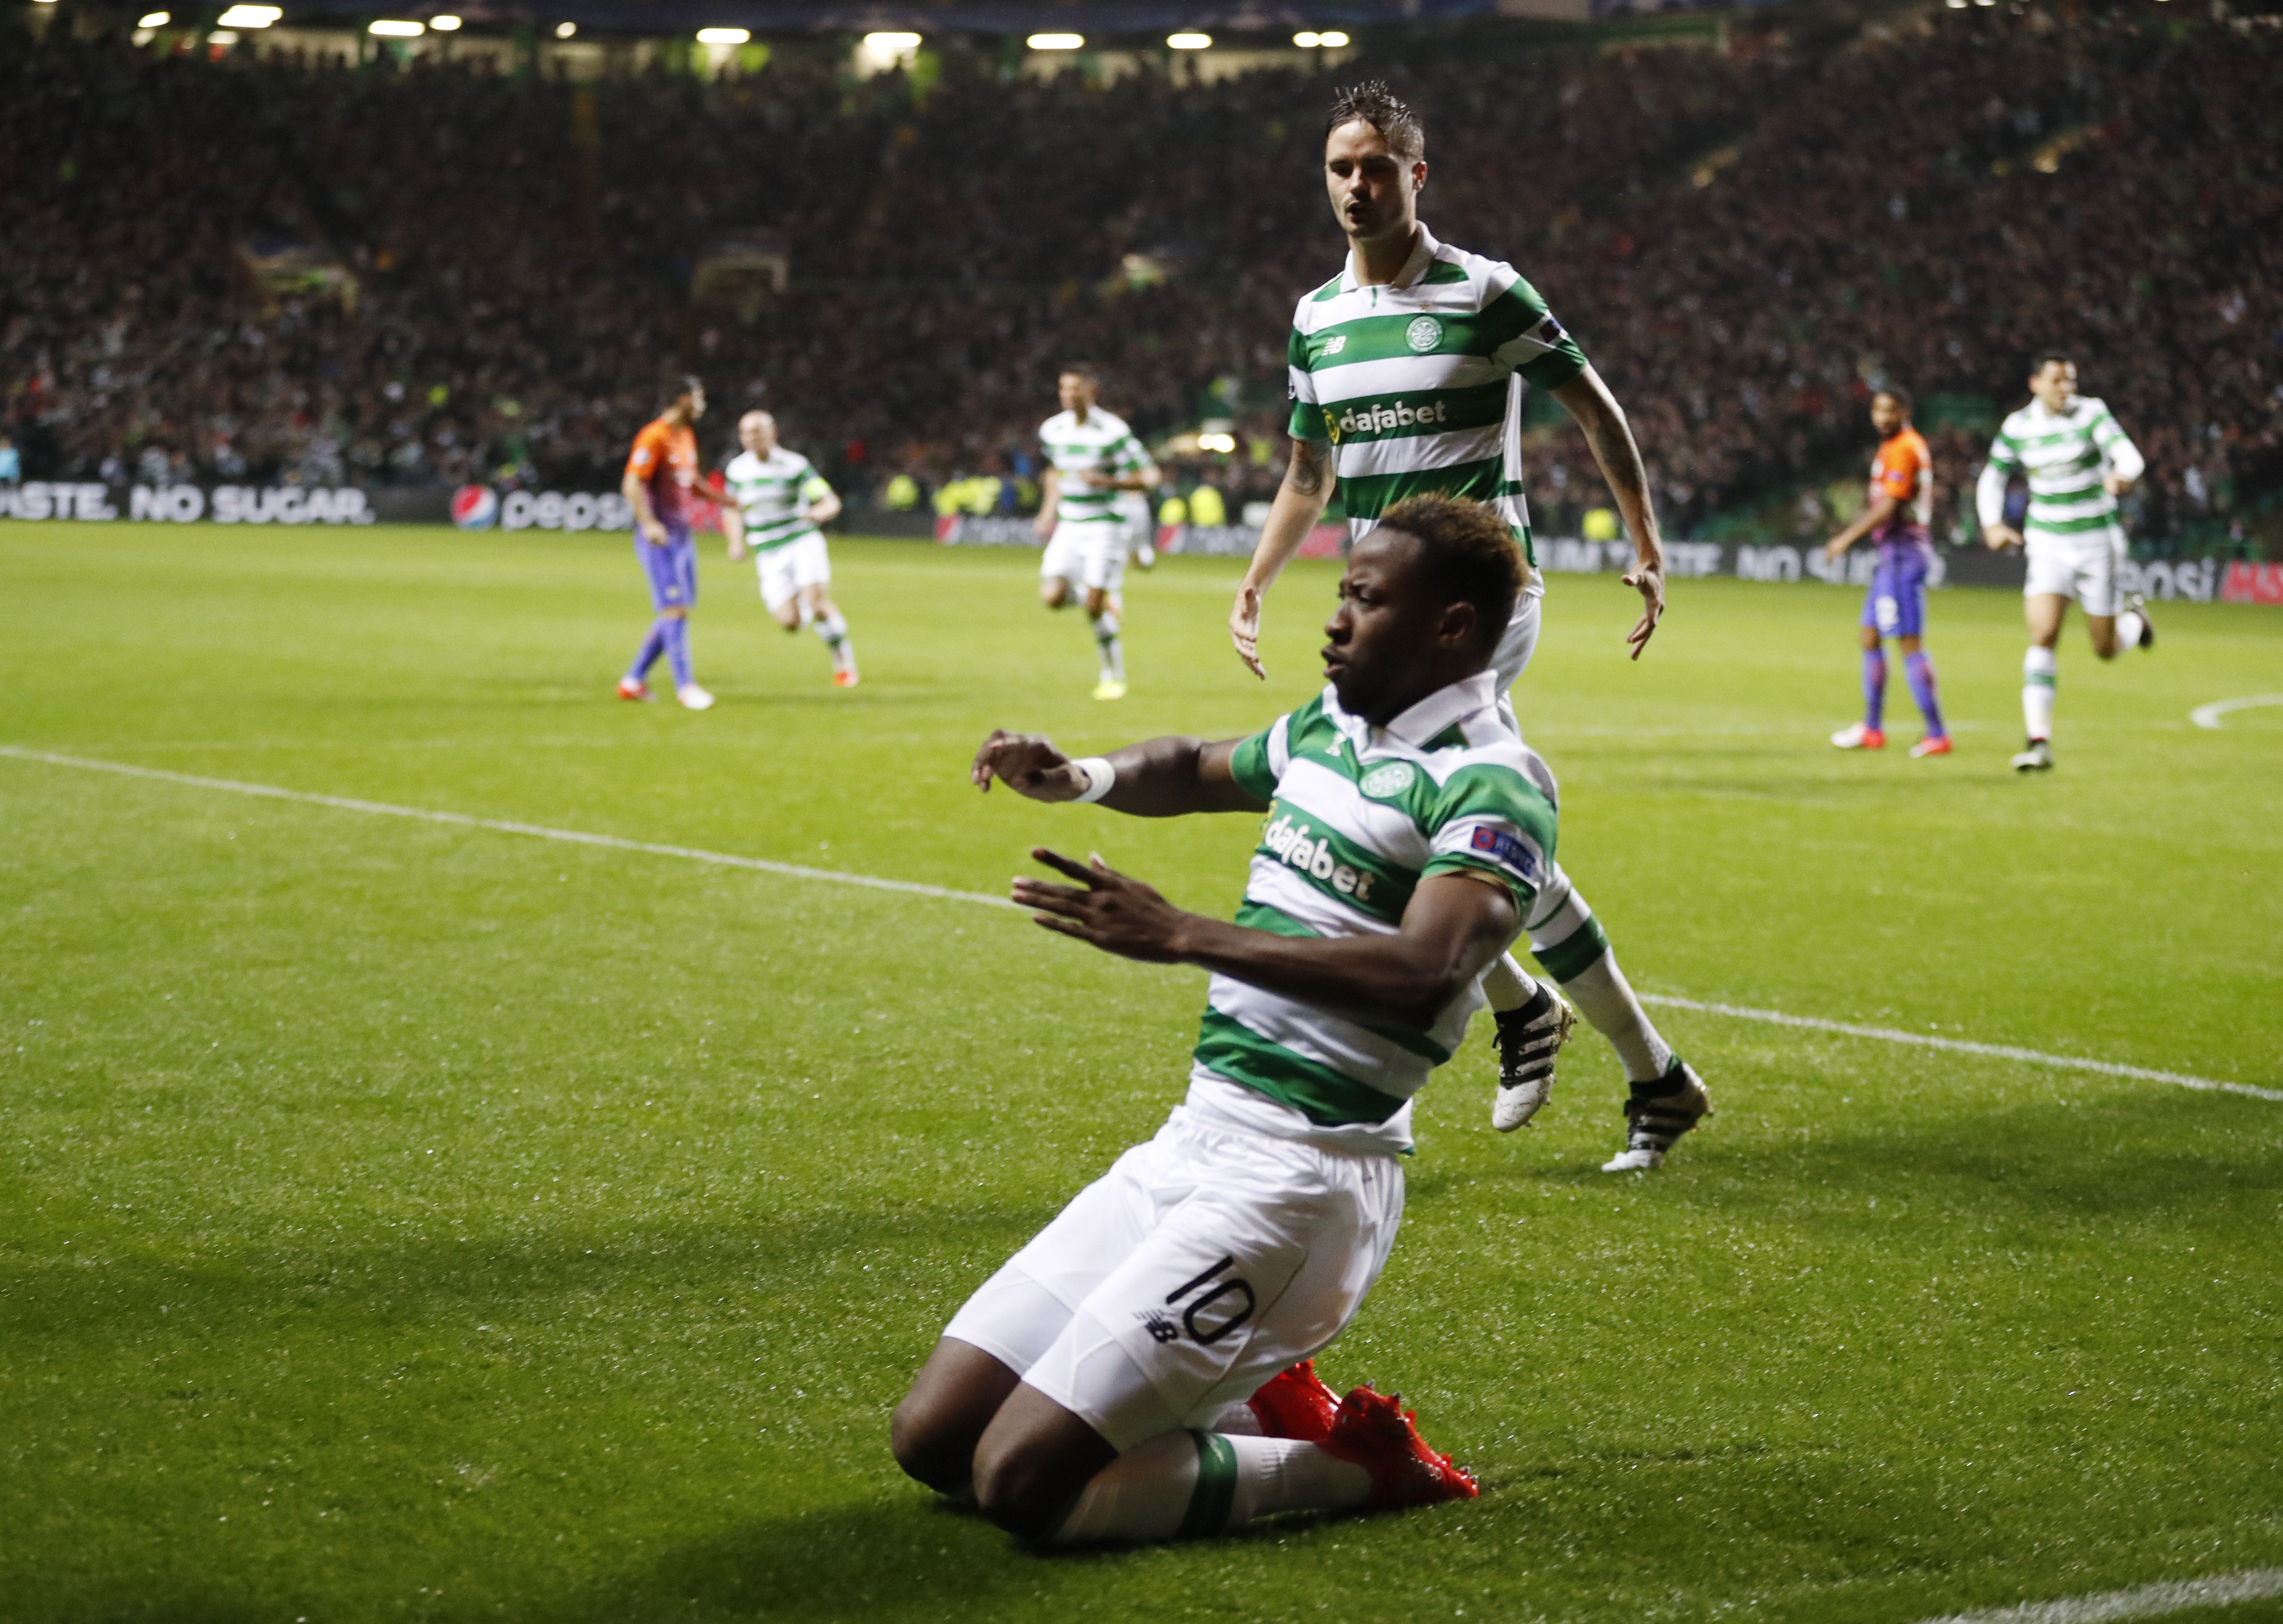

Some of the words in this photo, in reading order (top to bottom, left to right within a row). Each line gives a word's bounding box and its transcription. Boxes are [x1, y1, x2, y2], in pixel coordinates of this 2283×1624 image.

[1340, 400, 1446, 435] dafabet
[130, 484, 204, 522] NO
[1265, 814, 1374, 901] dafabet
[1166, 1255, 1255, 1346] 10
